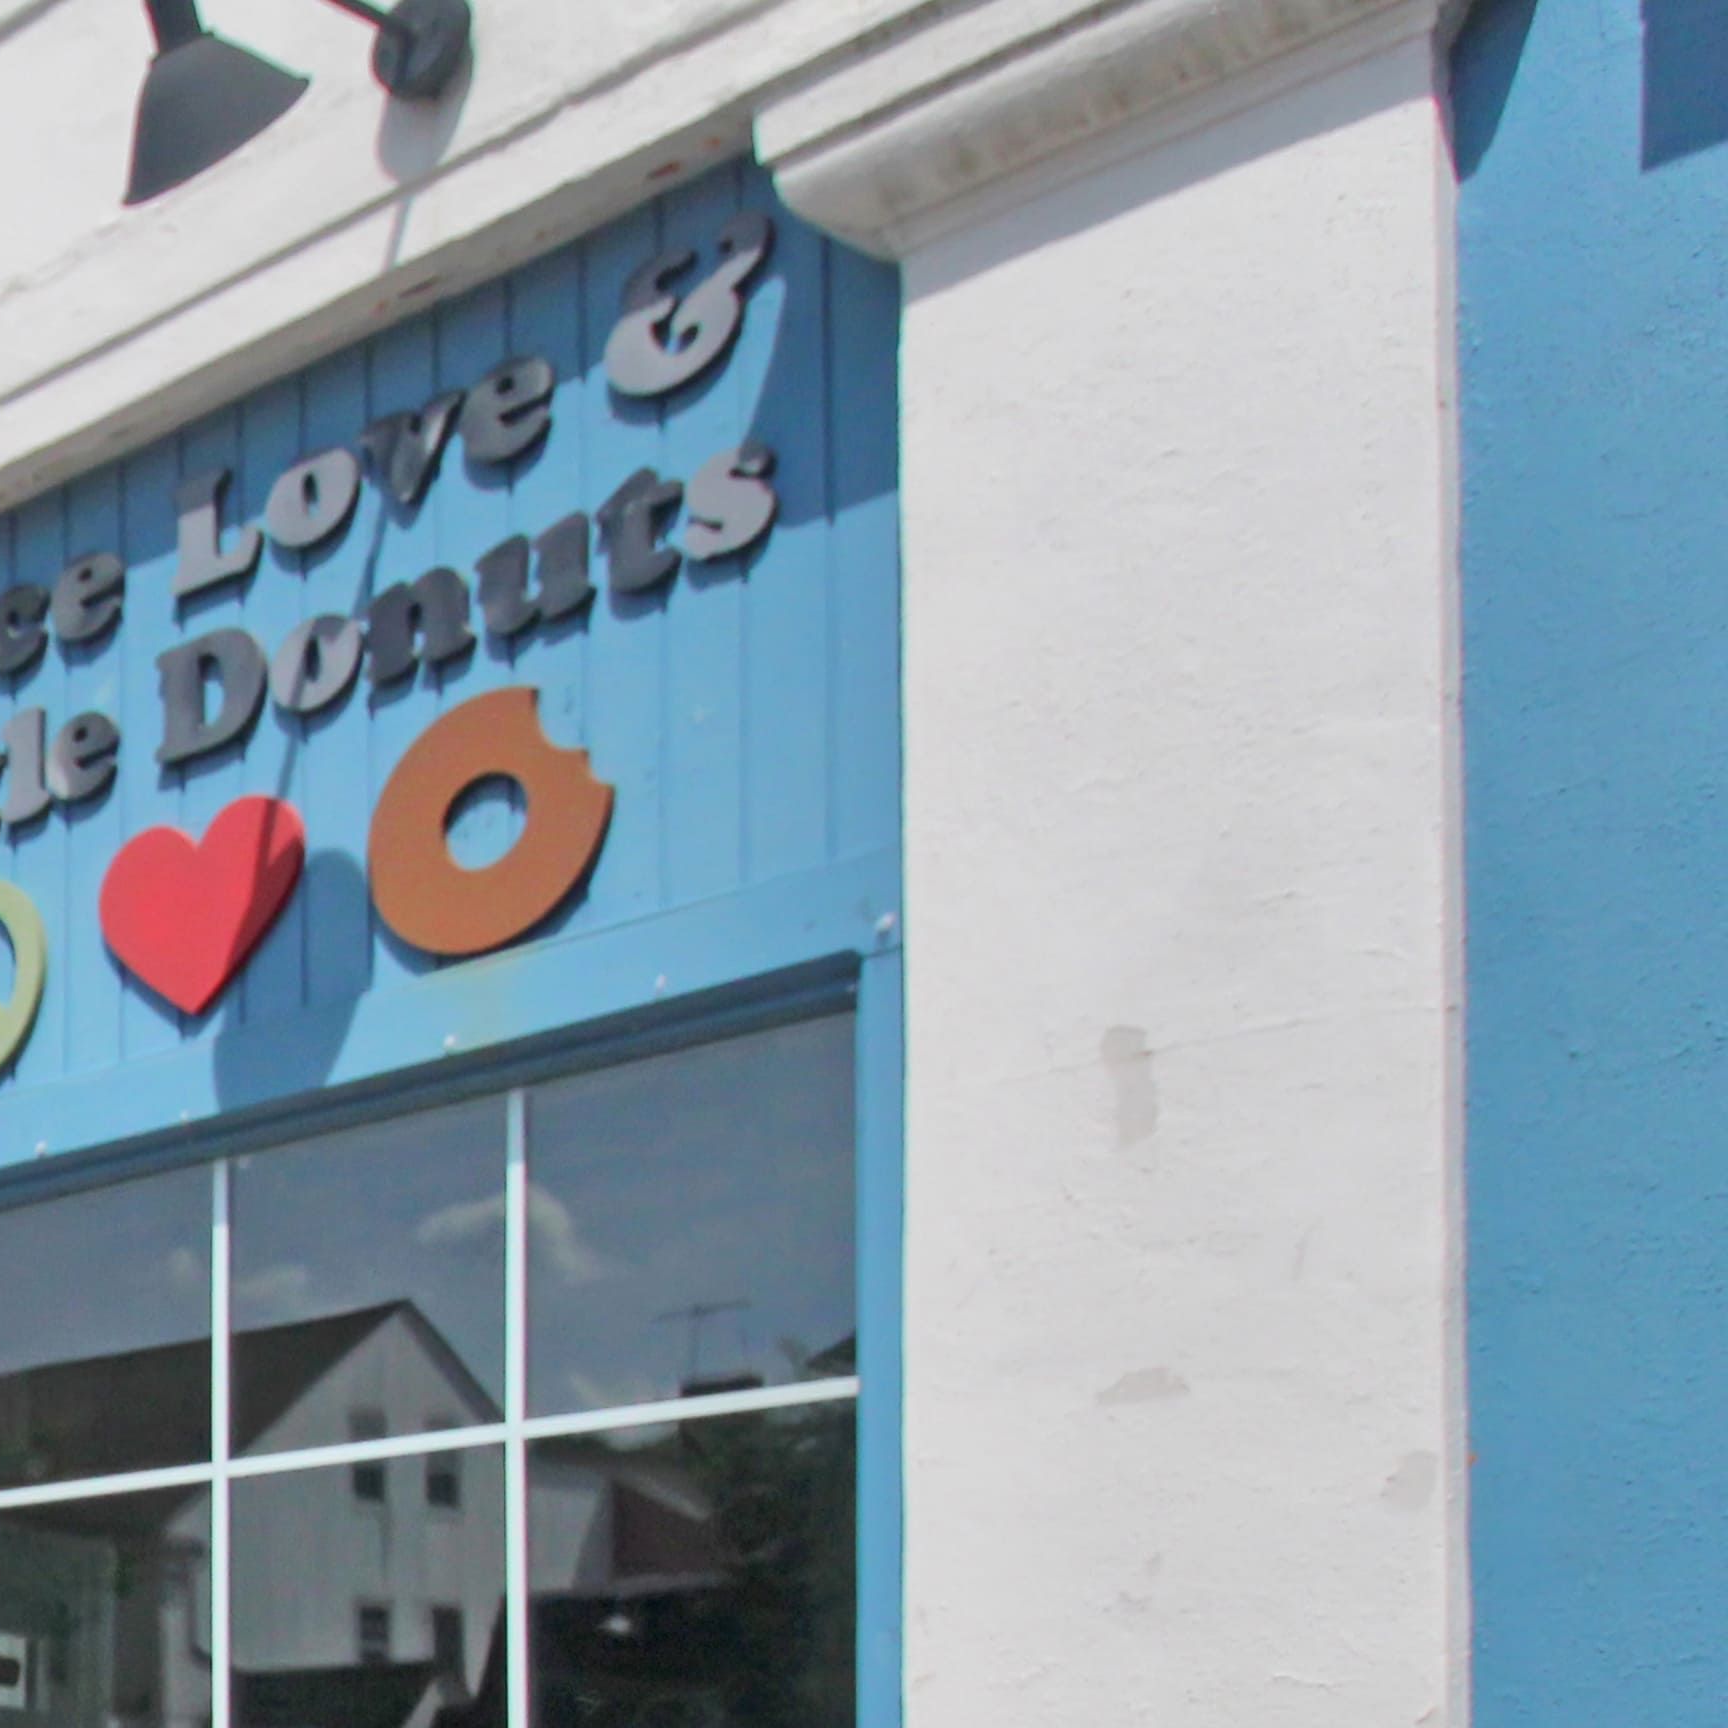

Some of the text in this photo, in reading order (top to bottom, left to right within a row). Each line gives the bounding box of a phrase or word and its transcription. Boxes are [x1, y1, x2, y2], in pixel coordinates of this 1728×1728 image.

[172, 358, 553, 598] Love
[603, 210, 775, 398] &
[155, 440, 777, 767] Donuts
